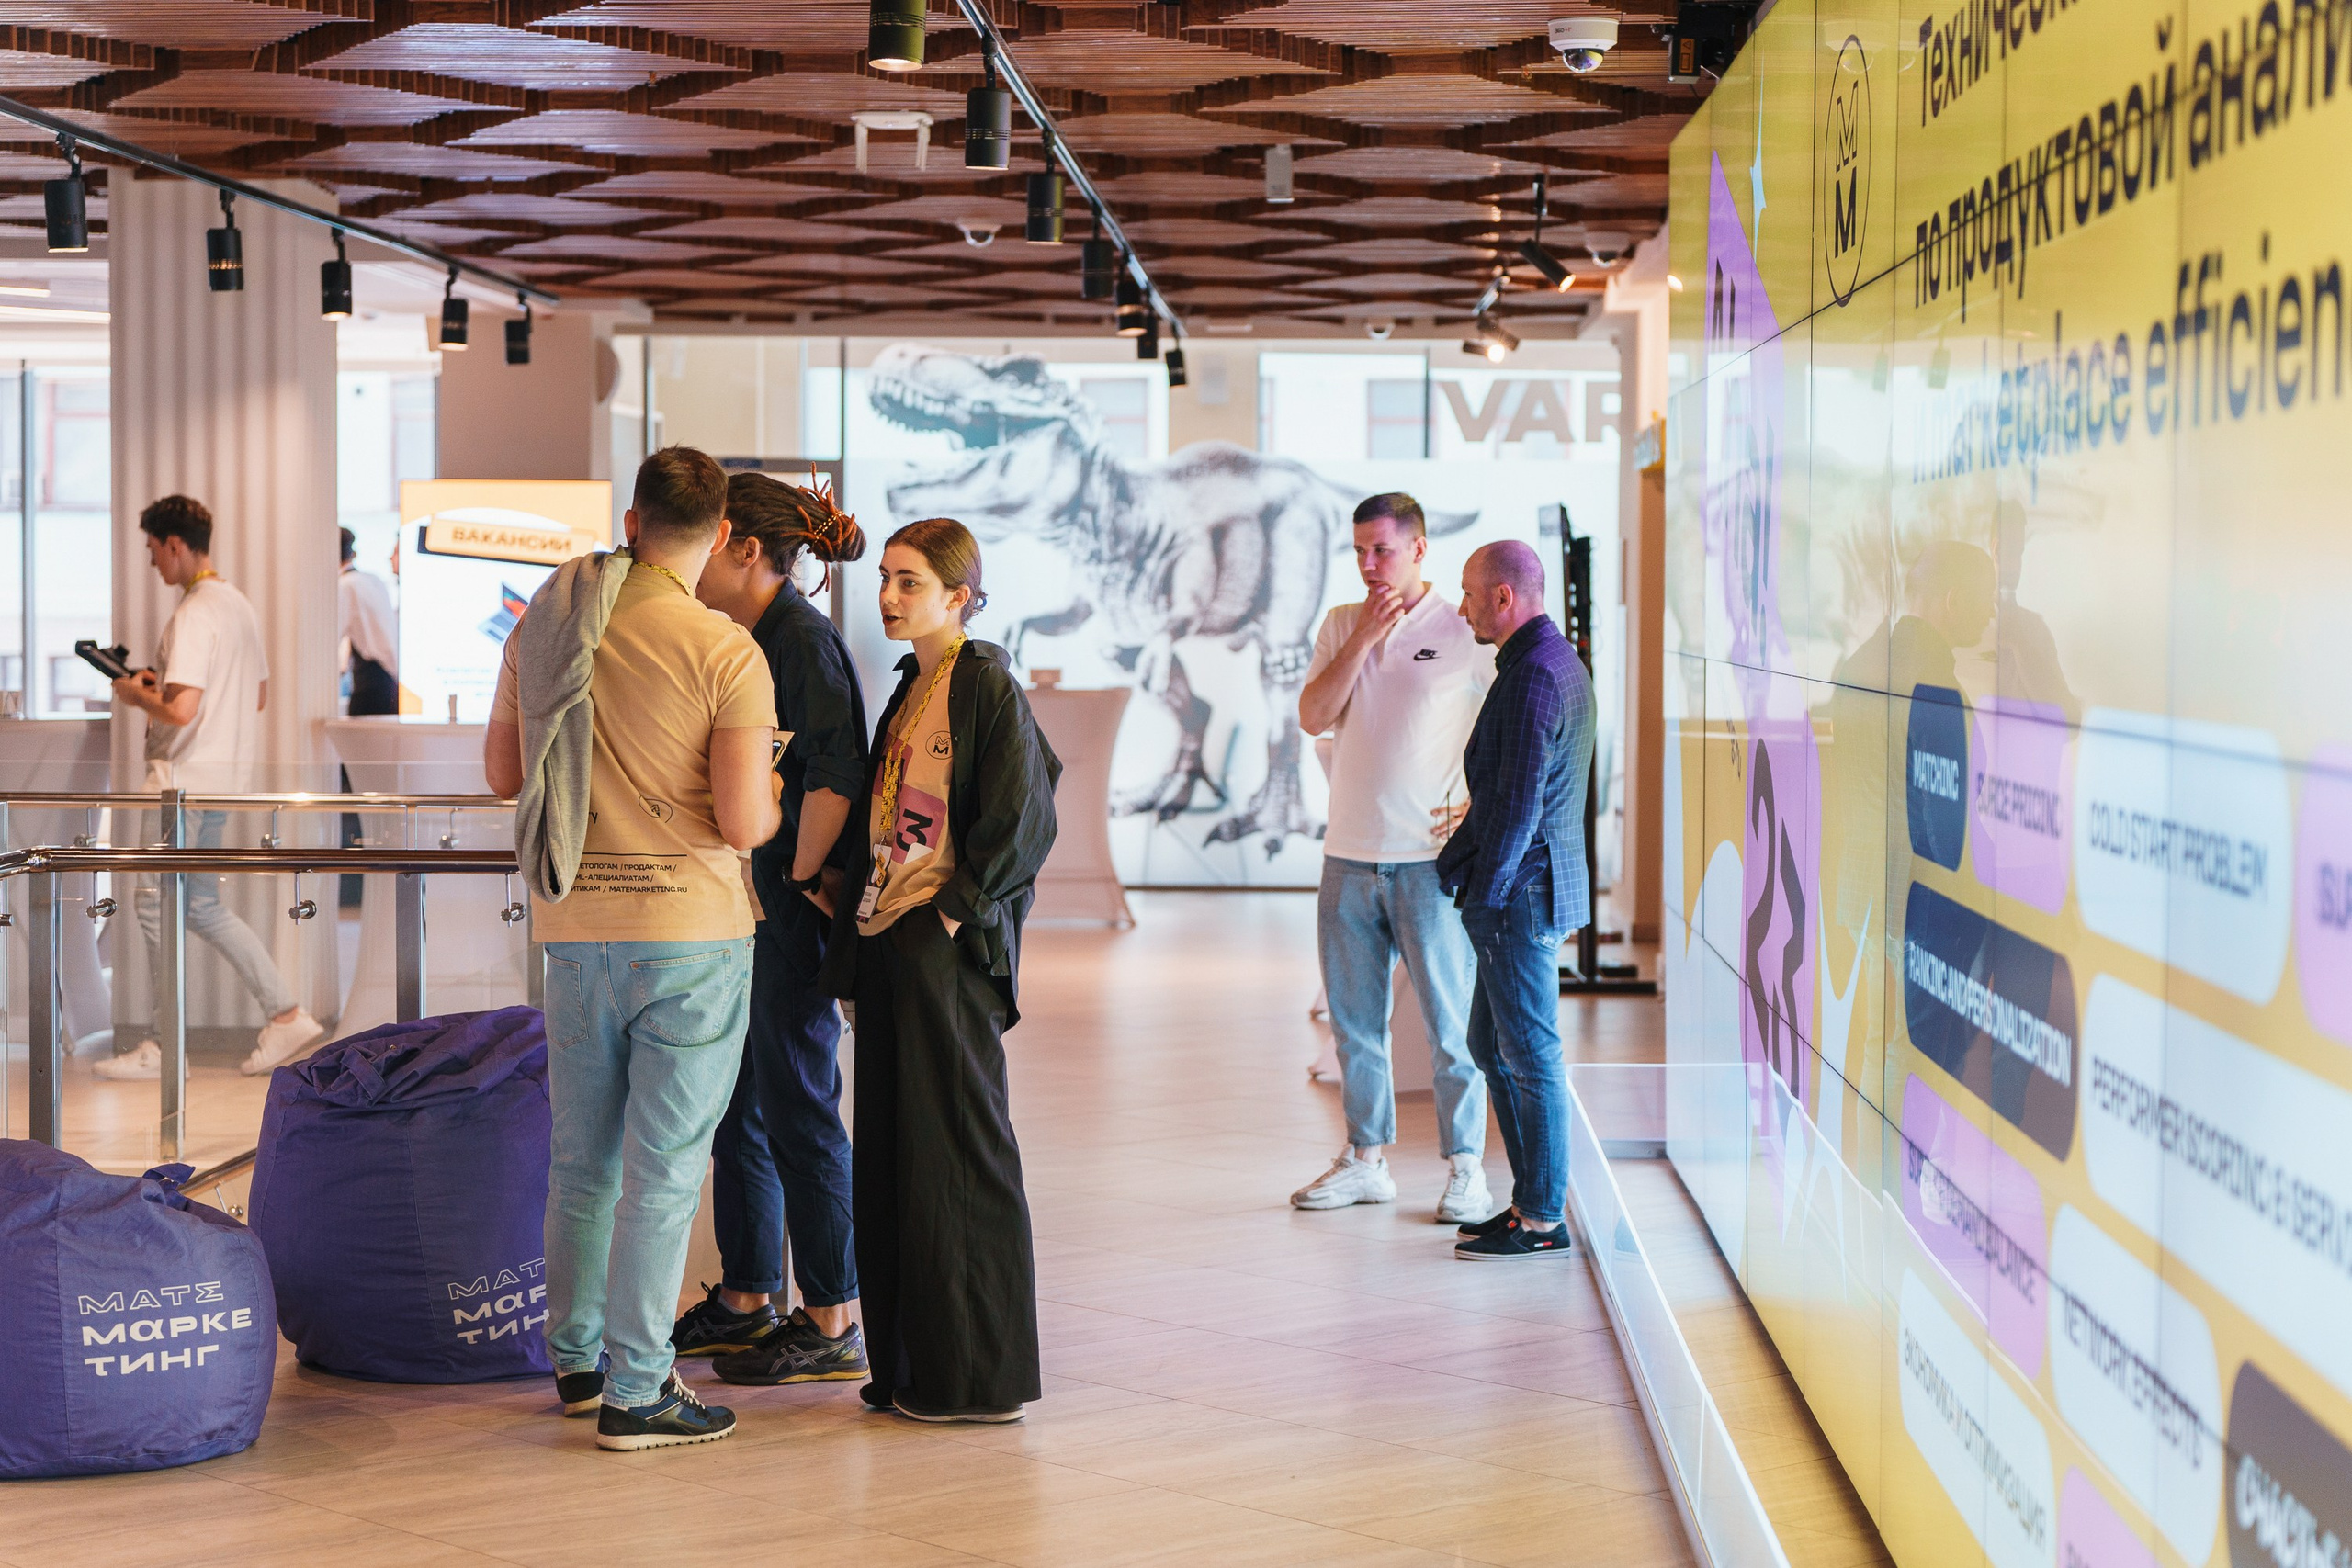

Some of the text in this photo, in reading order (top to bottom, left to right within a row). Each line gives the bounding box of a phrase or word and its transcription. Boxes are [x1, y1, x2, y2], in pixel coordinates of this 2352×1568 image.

[1919, 0, 2078, 128] Техниче
[1947, 14, 2177, 325] продуктовой
[2089, 800, 2268, 904] COLD START PROBLEM
